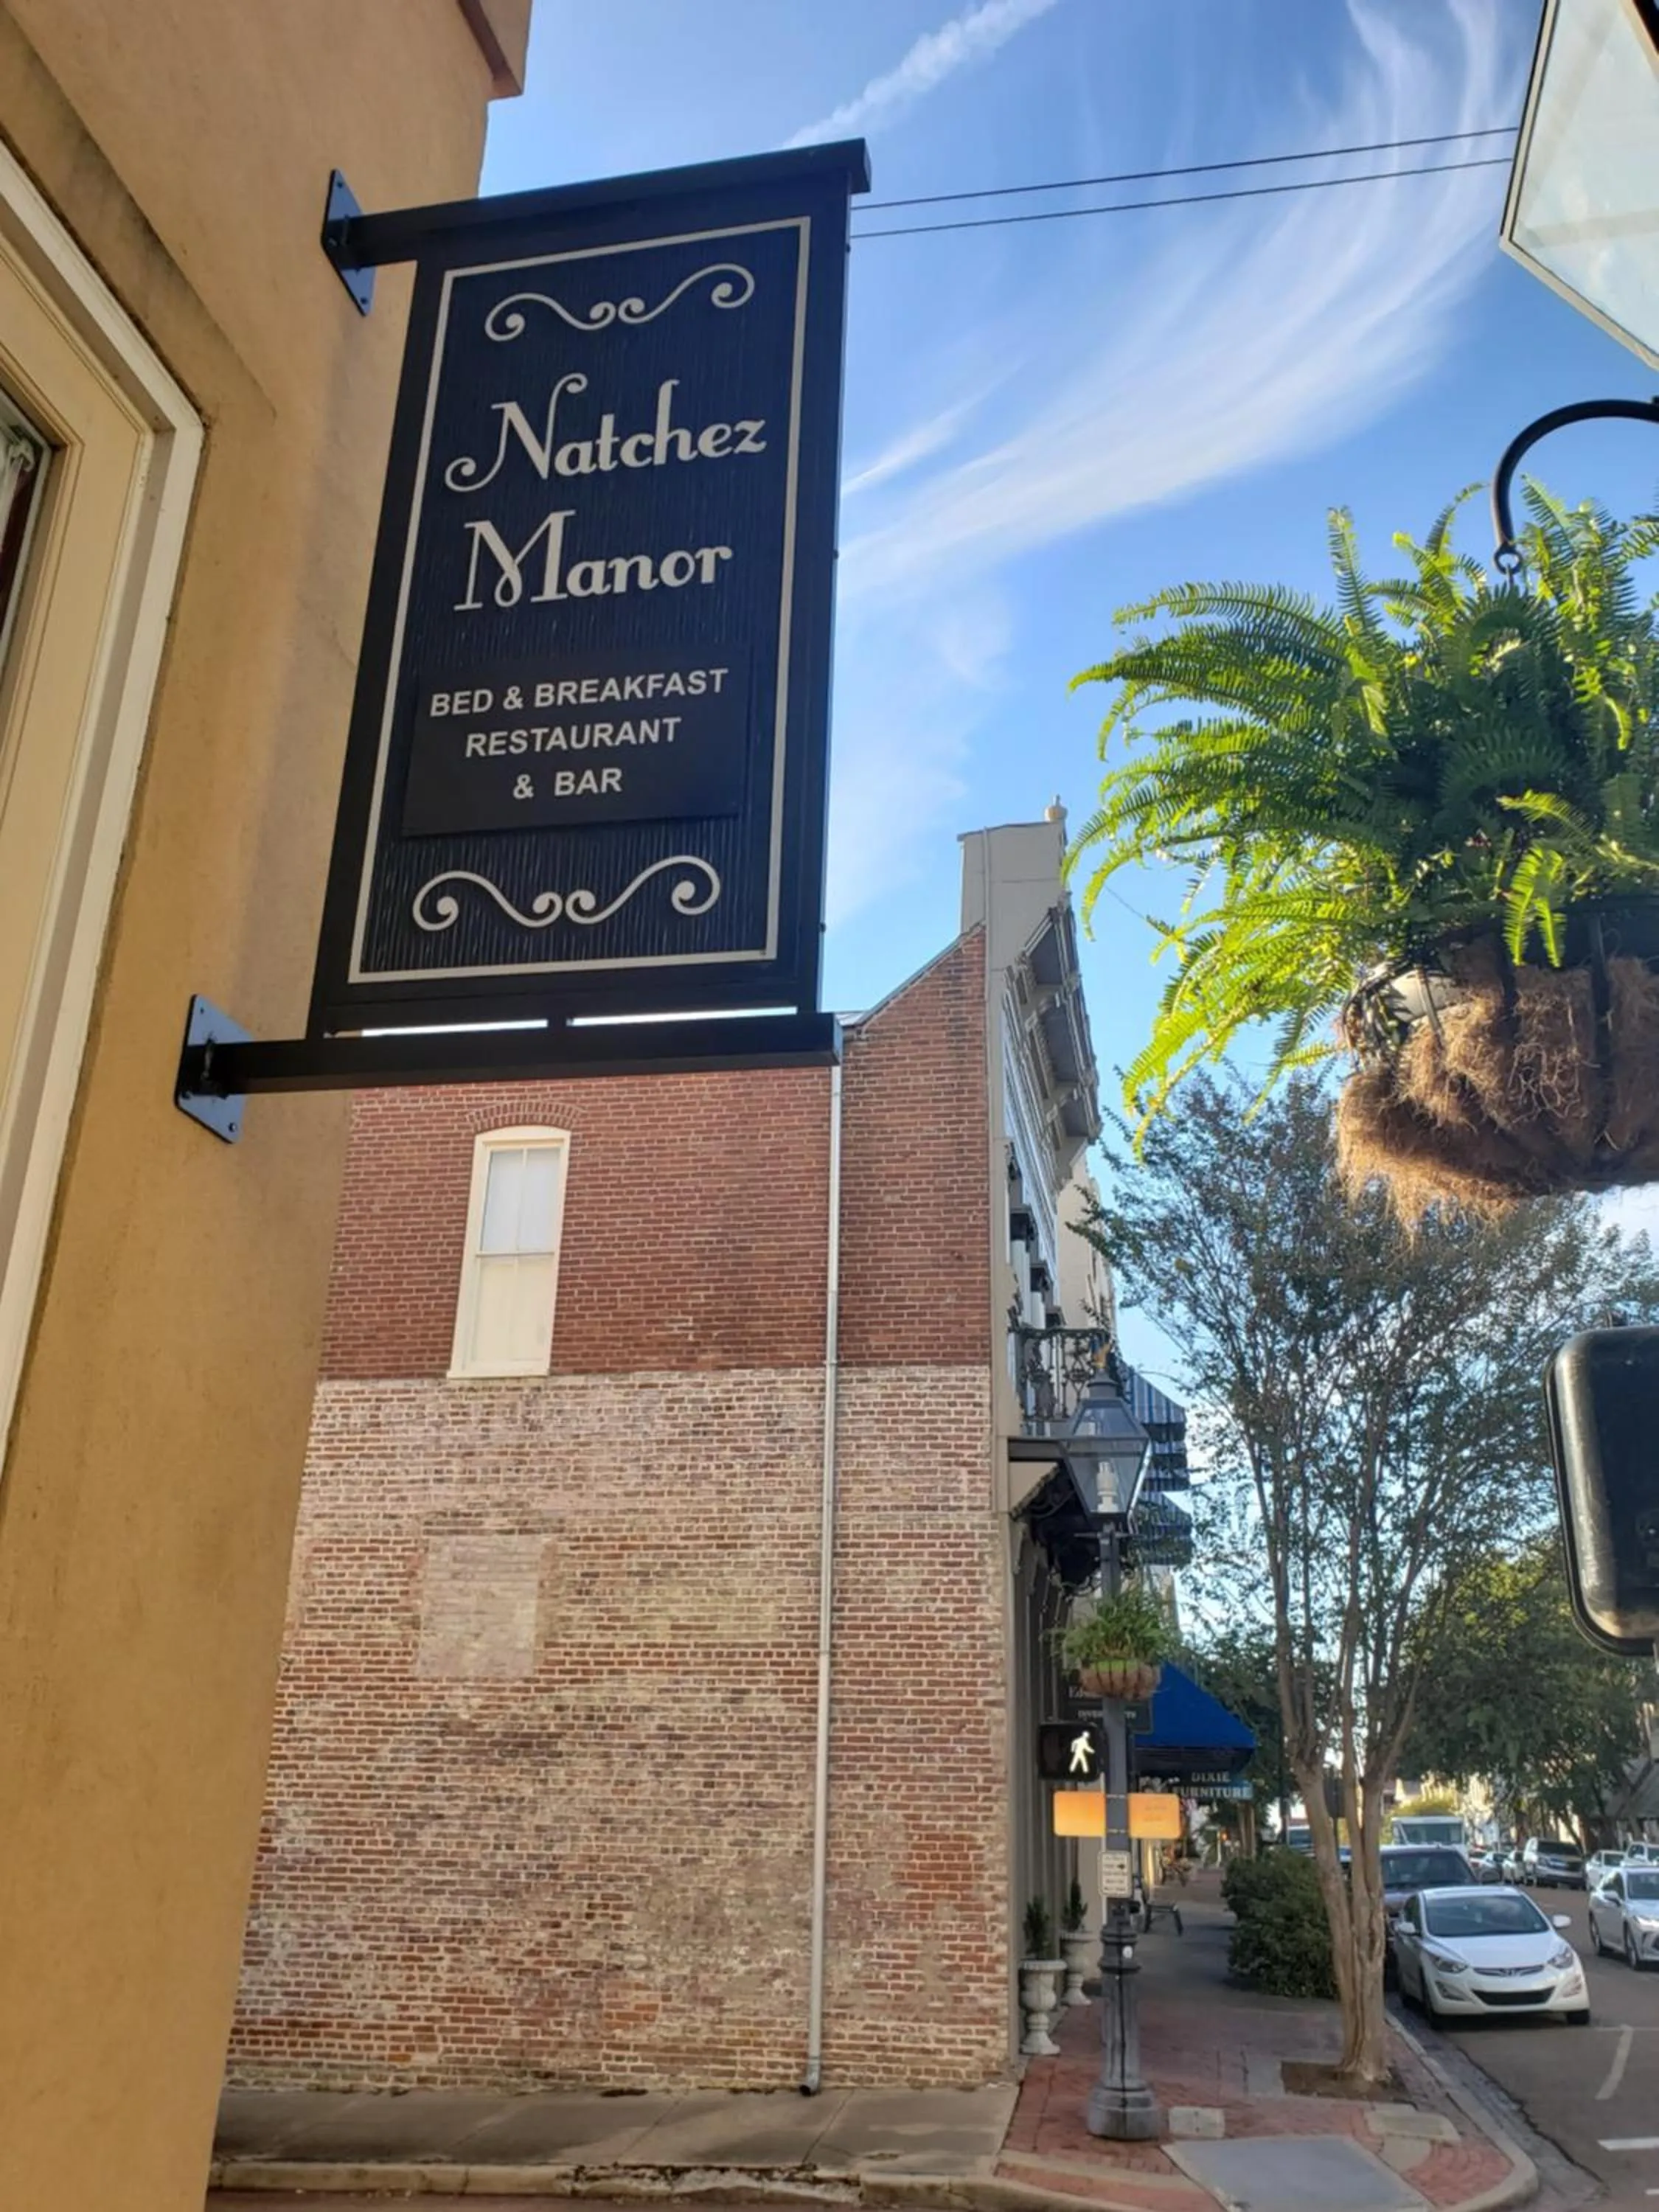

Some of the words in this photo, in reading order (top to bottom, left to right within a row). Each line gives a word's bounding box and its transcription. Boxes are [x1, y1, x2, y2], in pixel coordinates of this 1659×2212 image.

[445, 373, 766, 491] Natchez
[454, 510, 732, 611] Manor
[431, 689, 493, 717] BED
[503, 686, 523, 710] &
[535, 669, 728, 707] BREAKFAST
[466, 717, 681, 757] RESTAURANT
[513, 774, 534, 799] &
[554, 768, 622, 796] BAR
[1172, 1786, 1253, 1800] FURNITURE
[1191, 1771, 1231, 1783] DIXIE
